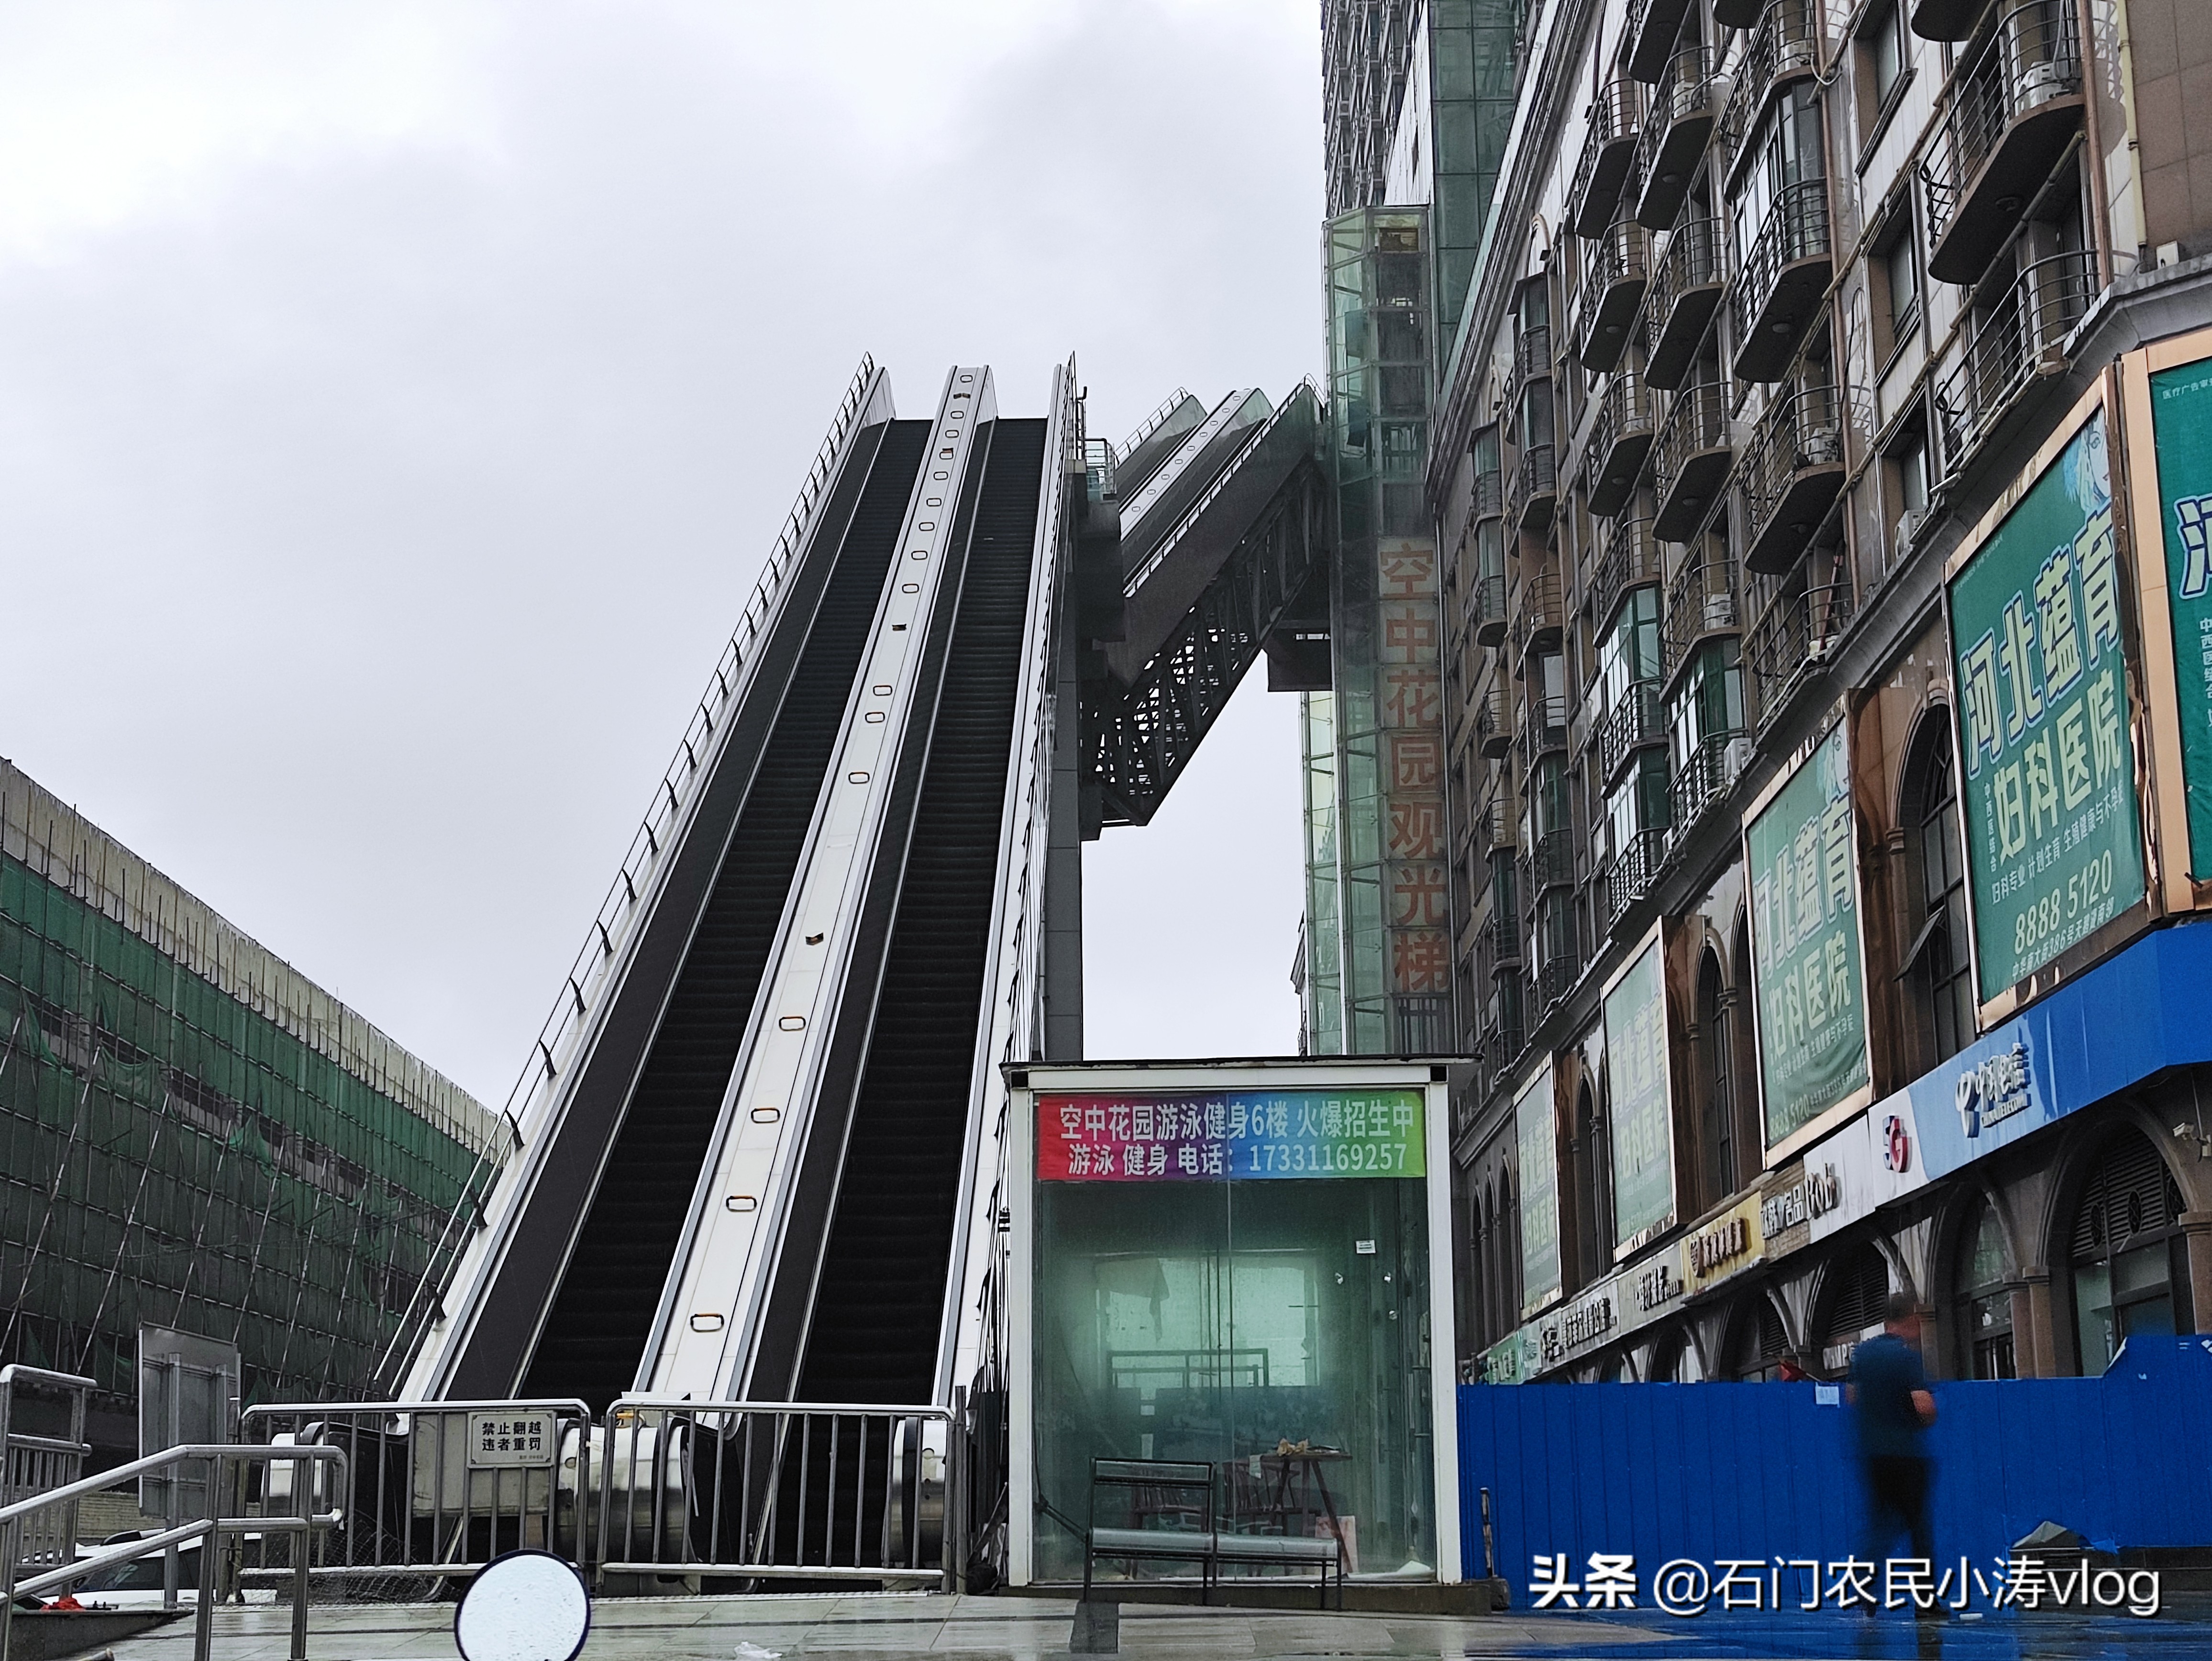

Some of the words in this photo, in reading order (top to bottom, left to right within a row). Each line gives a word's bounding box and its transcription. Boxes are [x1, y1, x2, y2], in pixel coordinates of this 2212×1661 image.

[1960, 502, 2120, 780] 河北蕴育
[1379, 543, 1449, 992] 空中花园观光梯
[1994, 669, 2121, 867] 妇科医院
[1752, 792, 1854, 989] 河北蕴育
[2014, 888, 2061, 955] 8888
[2067, 849, 2112, 919] 5120
[1769, 930, 1851, 1061] 妇科医院
[1060, 1102, 1288, 1141] 空中花园游泳健身6楼
[1296, 1099, 1414, 1139] 火爆招生中
[1068, 1145, 1114, 1175] 游泳
[1123, 1144, 1167, 1175] 健身
[1249, 1143, 1407, 1173] 17331169257
[482, 1421, 542, 1436] 禁止翻越
[482, 1437, 541, 1451] 违者重罚
